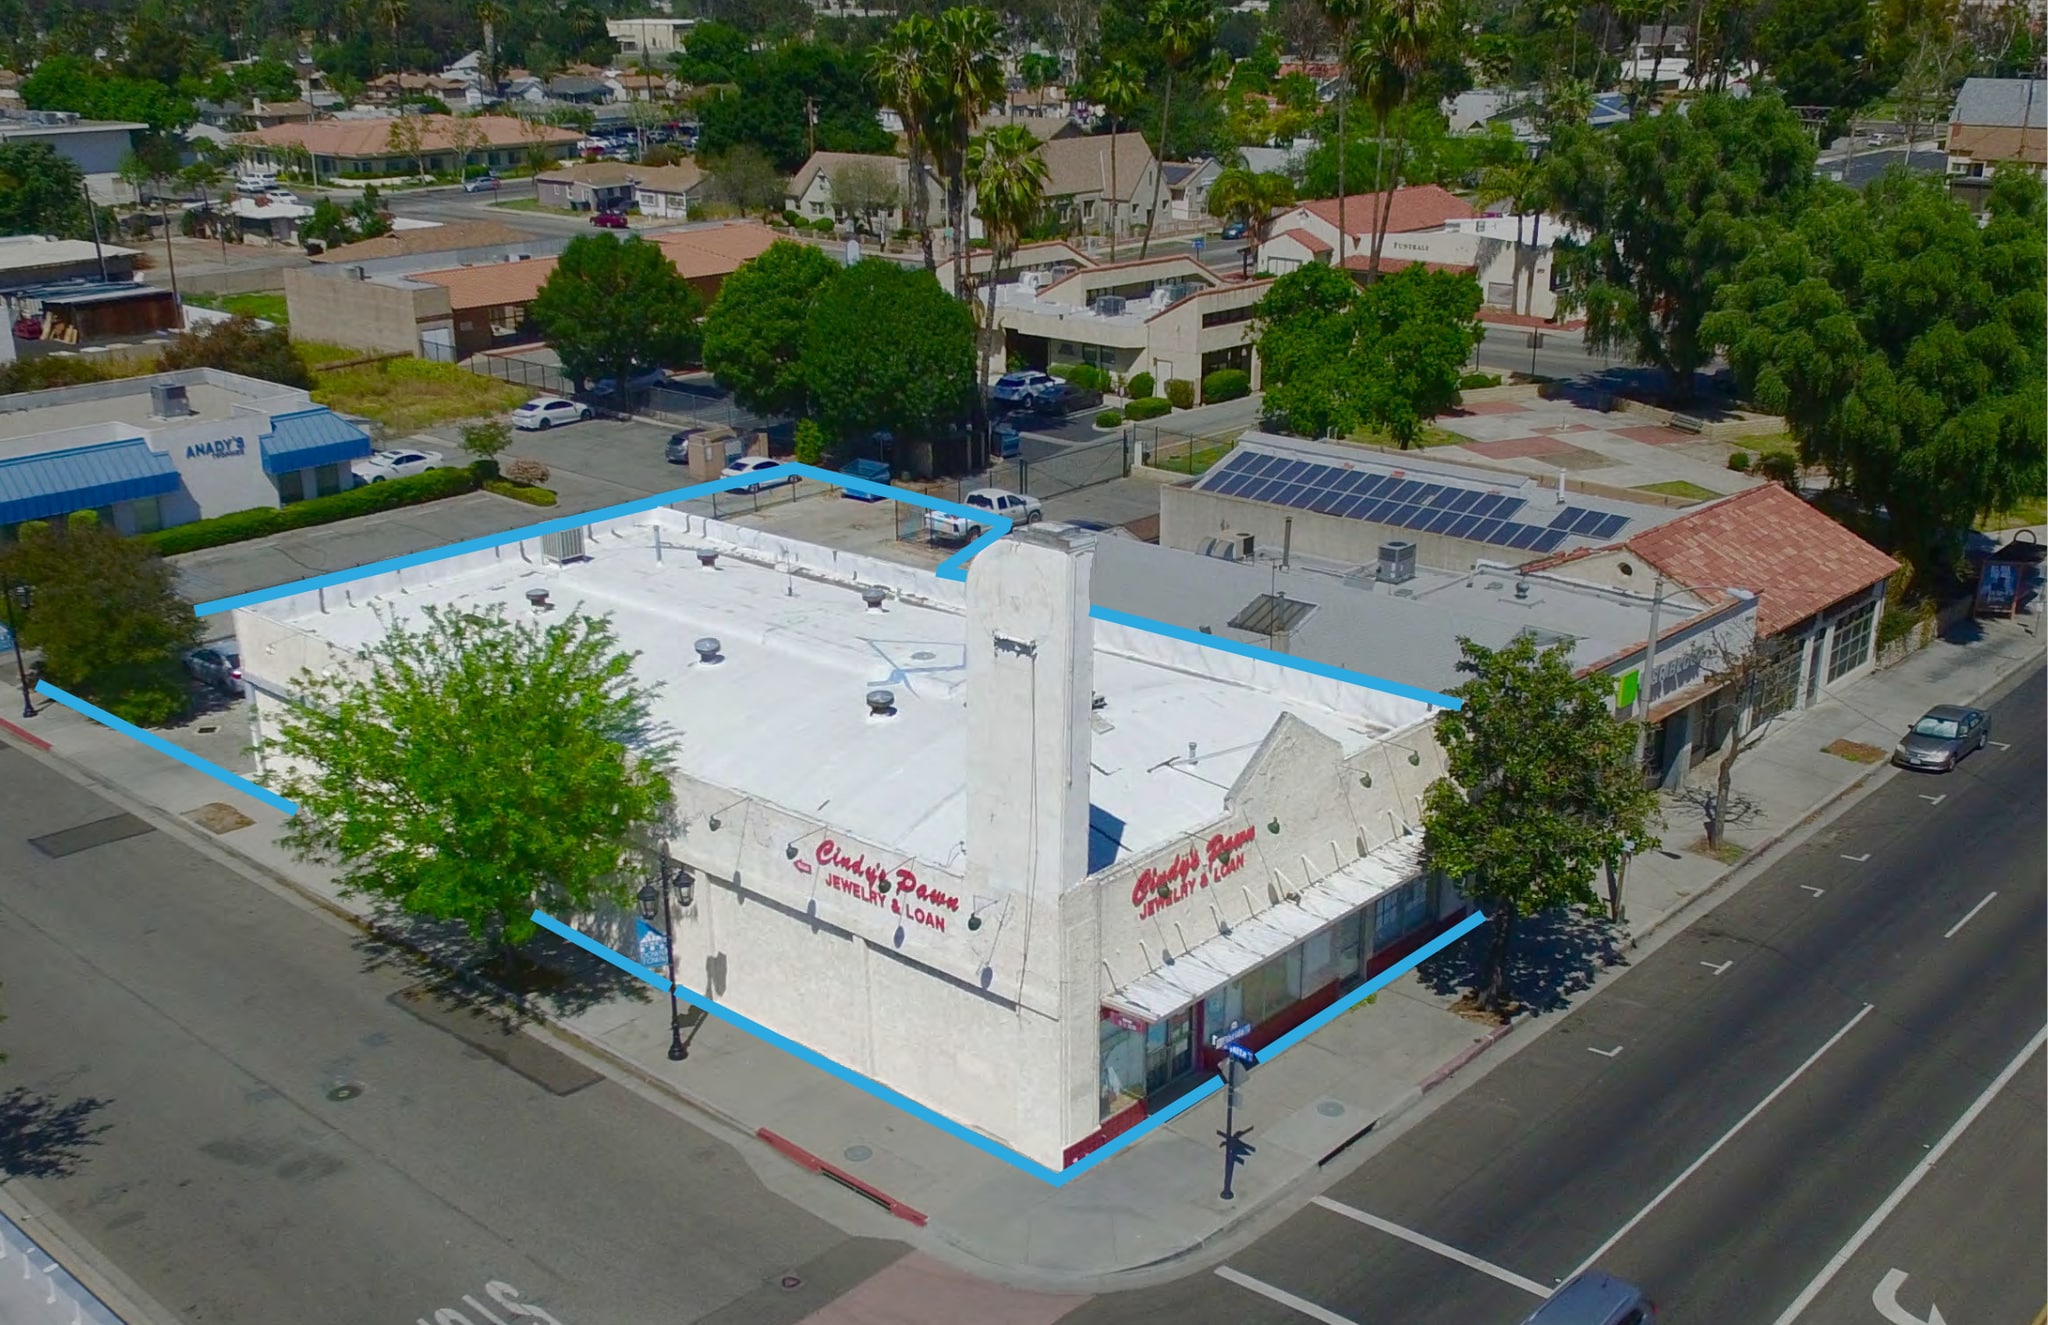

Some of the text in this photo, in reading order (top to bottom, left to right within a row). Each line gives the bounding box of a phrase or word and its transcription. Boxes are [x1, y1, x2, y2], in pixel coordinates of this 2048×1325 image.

[815, 839, 959, 912] Cindy's Pawn
[1131, 825, 1256, 907] Cindy's Pawn
[1139, 878, 1196, 920] JEWELRY
[1214, 853, 1245, 883] LOAN
[825, 873, 945, 933] JEWELRY & LOAN
